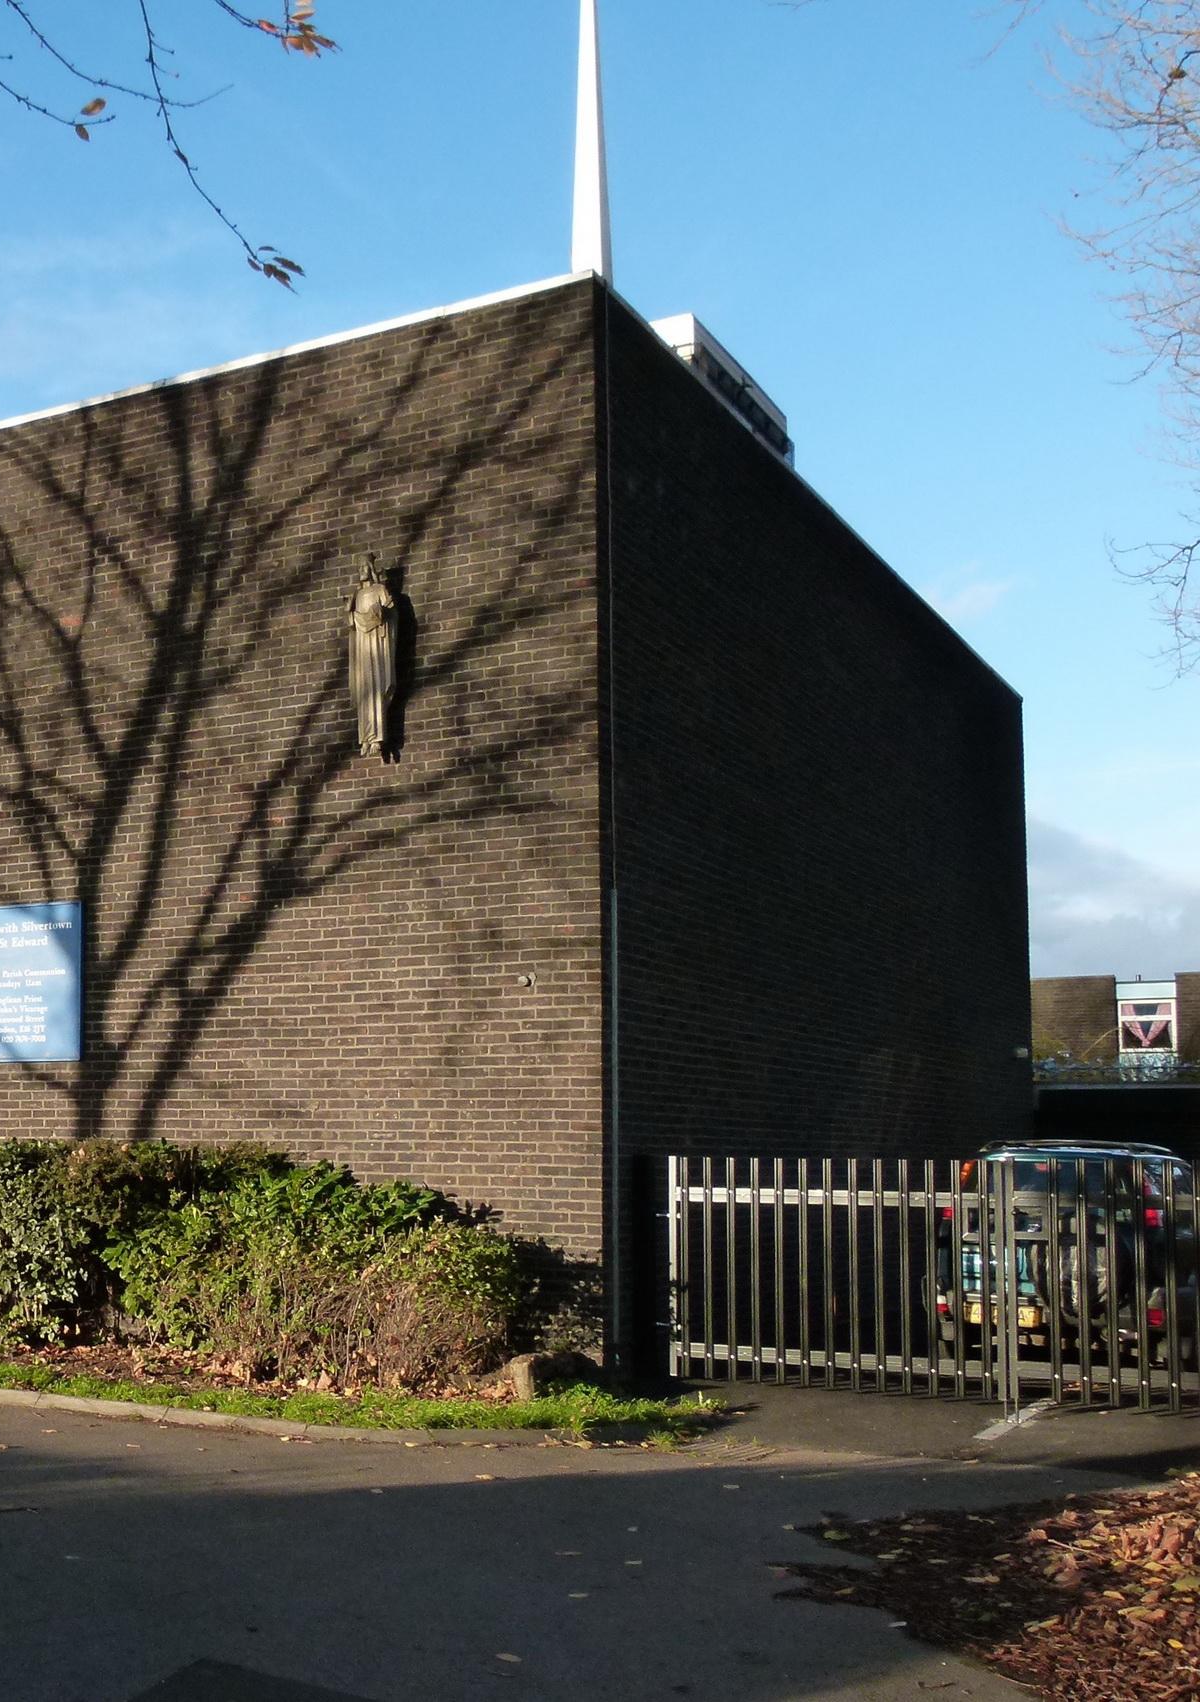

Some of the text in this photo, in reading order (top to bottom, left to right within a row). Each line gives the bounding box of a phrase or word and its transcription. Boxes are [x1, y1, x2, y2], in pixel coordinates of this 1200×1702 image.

[22, 921, 72, 931] Silvertown
[0, 939, 7, 948] St
[12, 937, 47, 947] Edward
[3, 969, 22, 978] Parish
[24, 967, 65, 977] Communion
